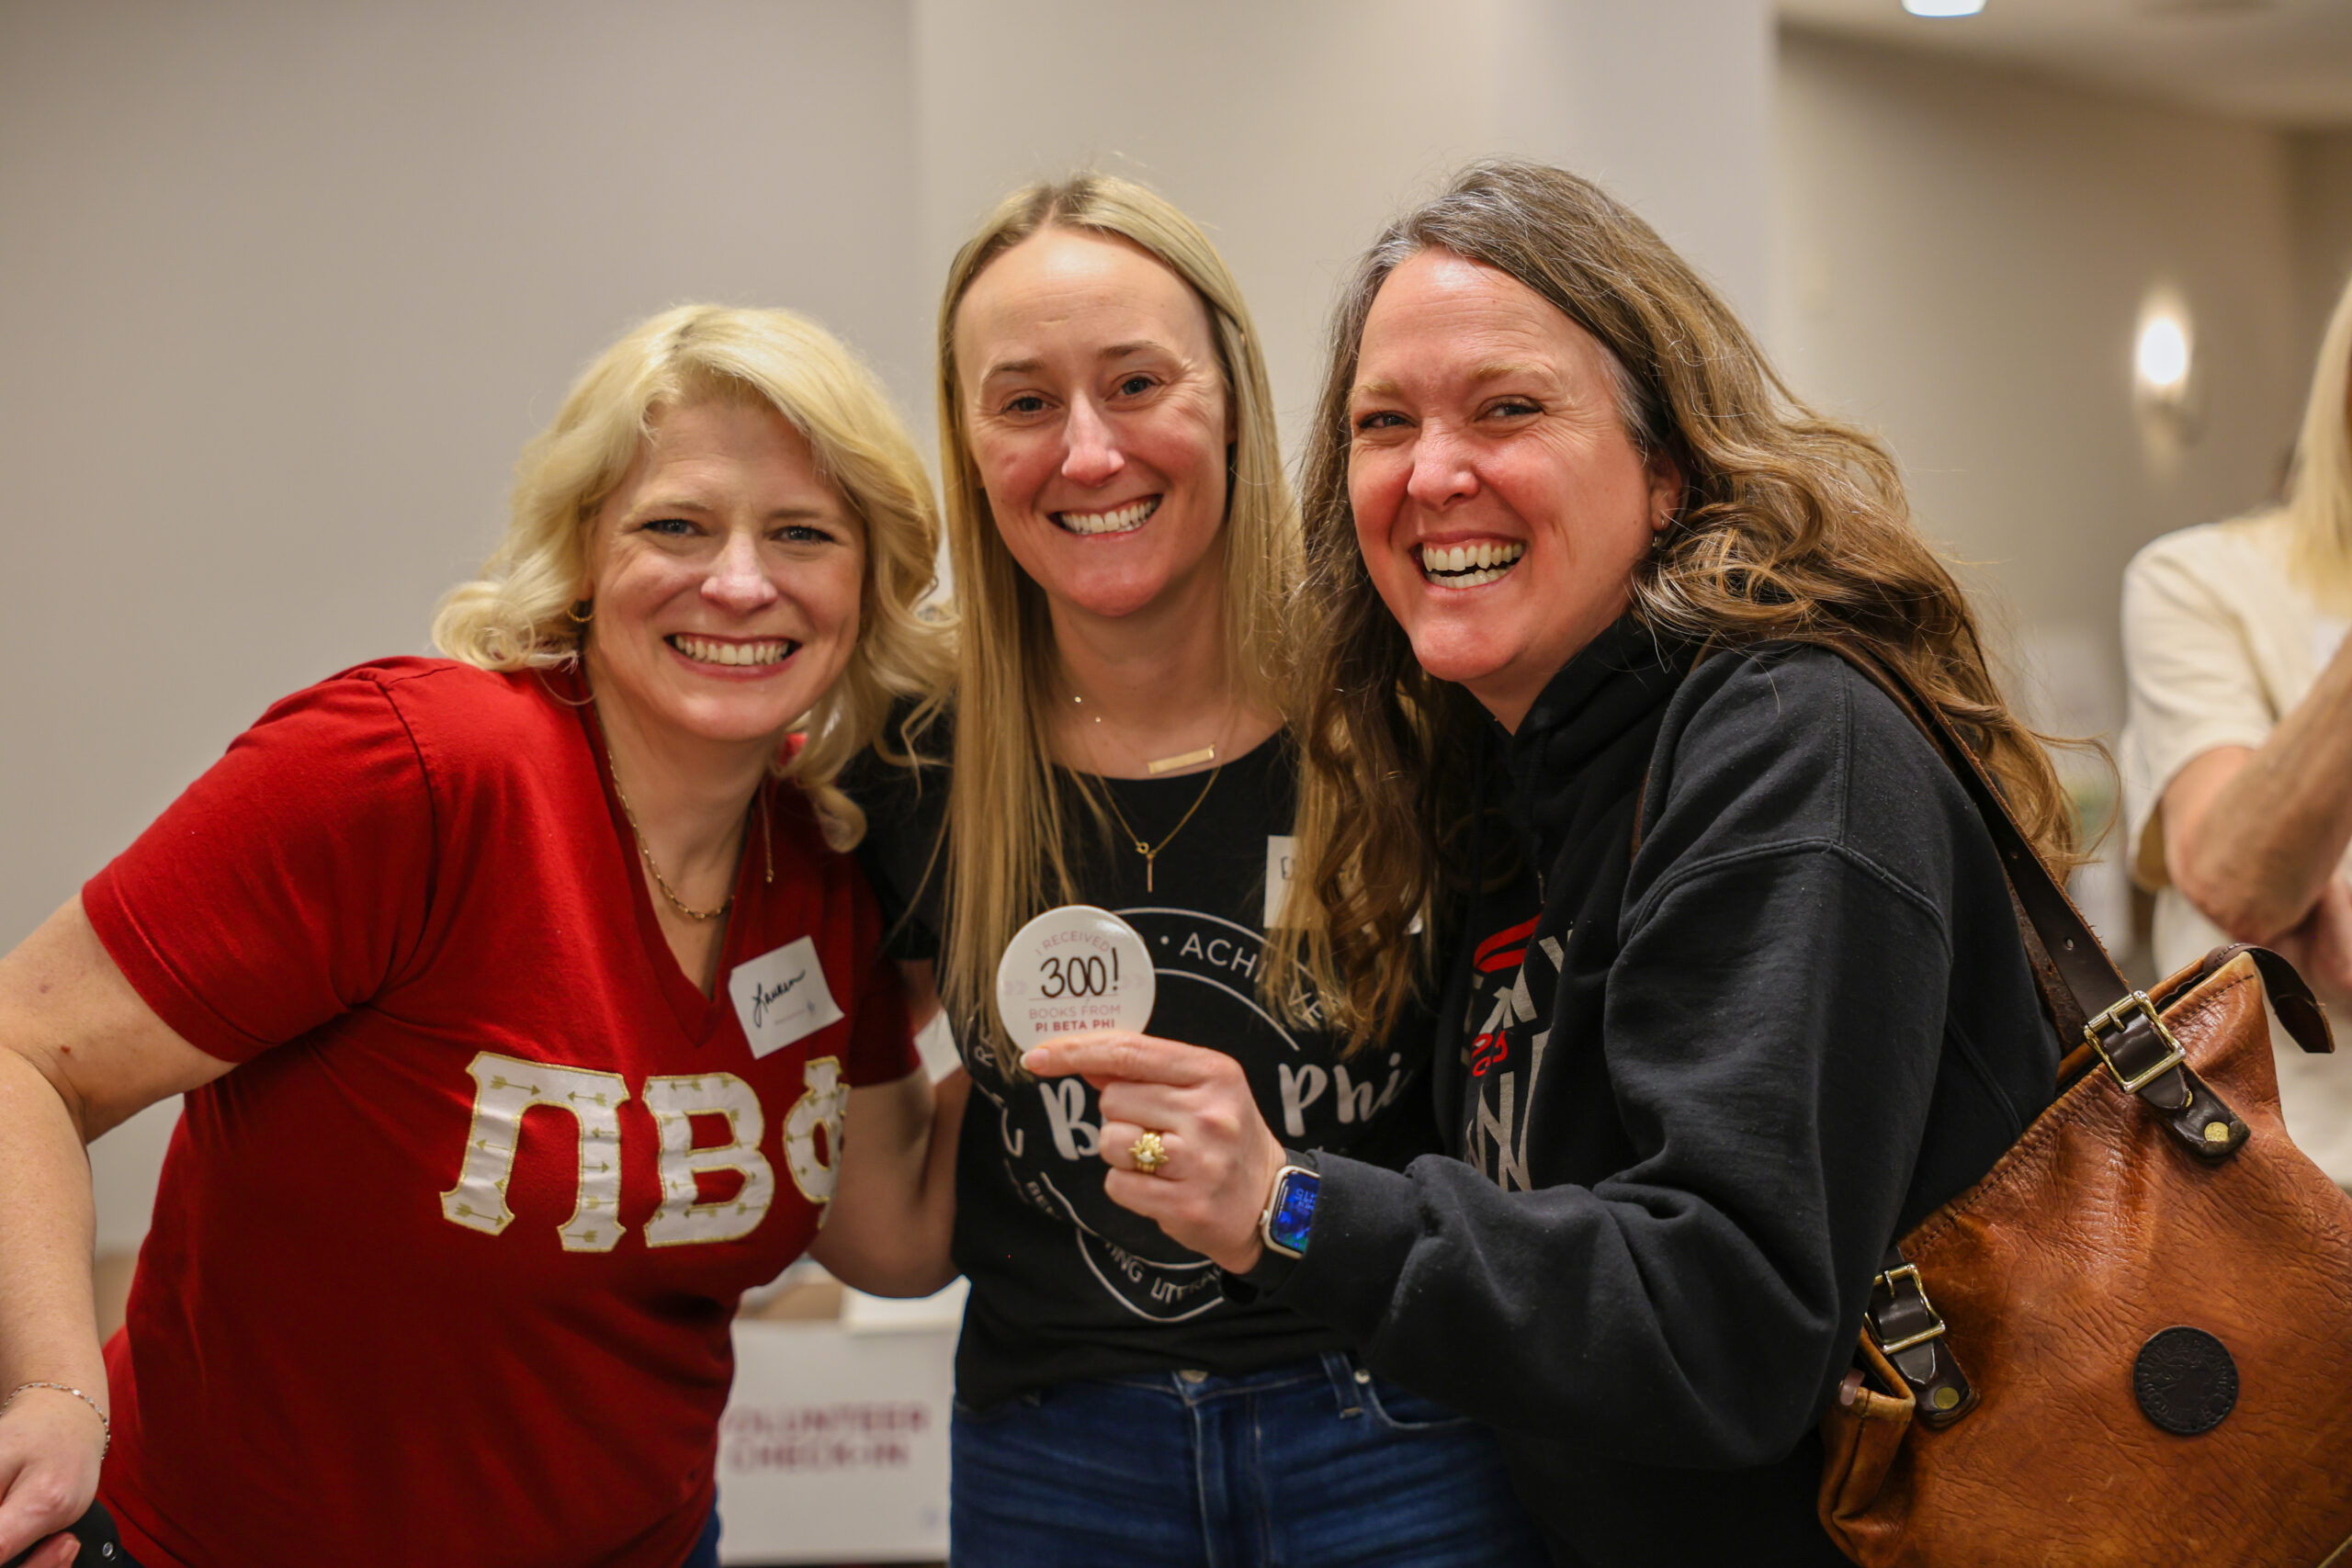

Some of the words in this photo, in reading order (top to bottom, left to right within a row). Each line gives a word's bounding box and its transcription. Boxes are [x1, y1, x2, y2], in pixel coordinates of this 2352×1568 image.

[1042, 931, 1111, 953] RECEIVED
[1040, 947, 1118, 998] 300!
[1029, 1006, 1077, 1020] BOOKS
[1081, 1004, 1121, 1016] FROM
[1035, 1021, 1048, 1032] PI
[1053, 1020, 1087, 1032] BETA
[1092, 1019, 1115, 1029] PHI
[1278, 1052, 1408, 1138] Phi
